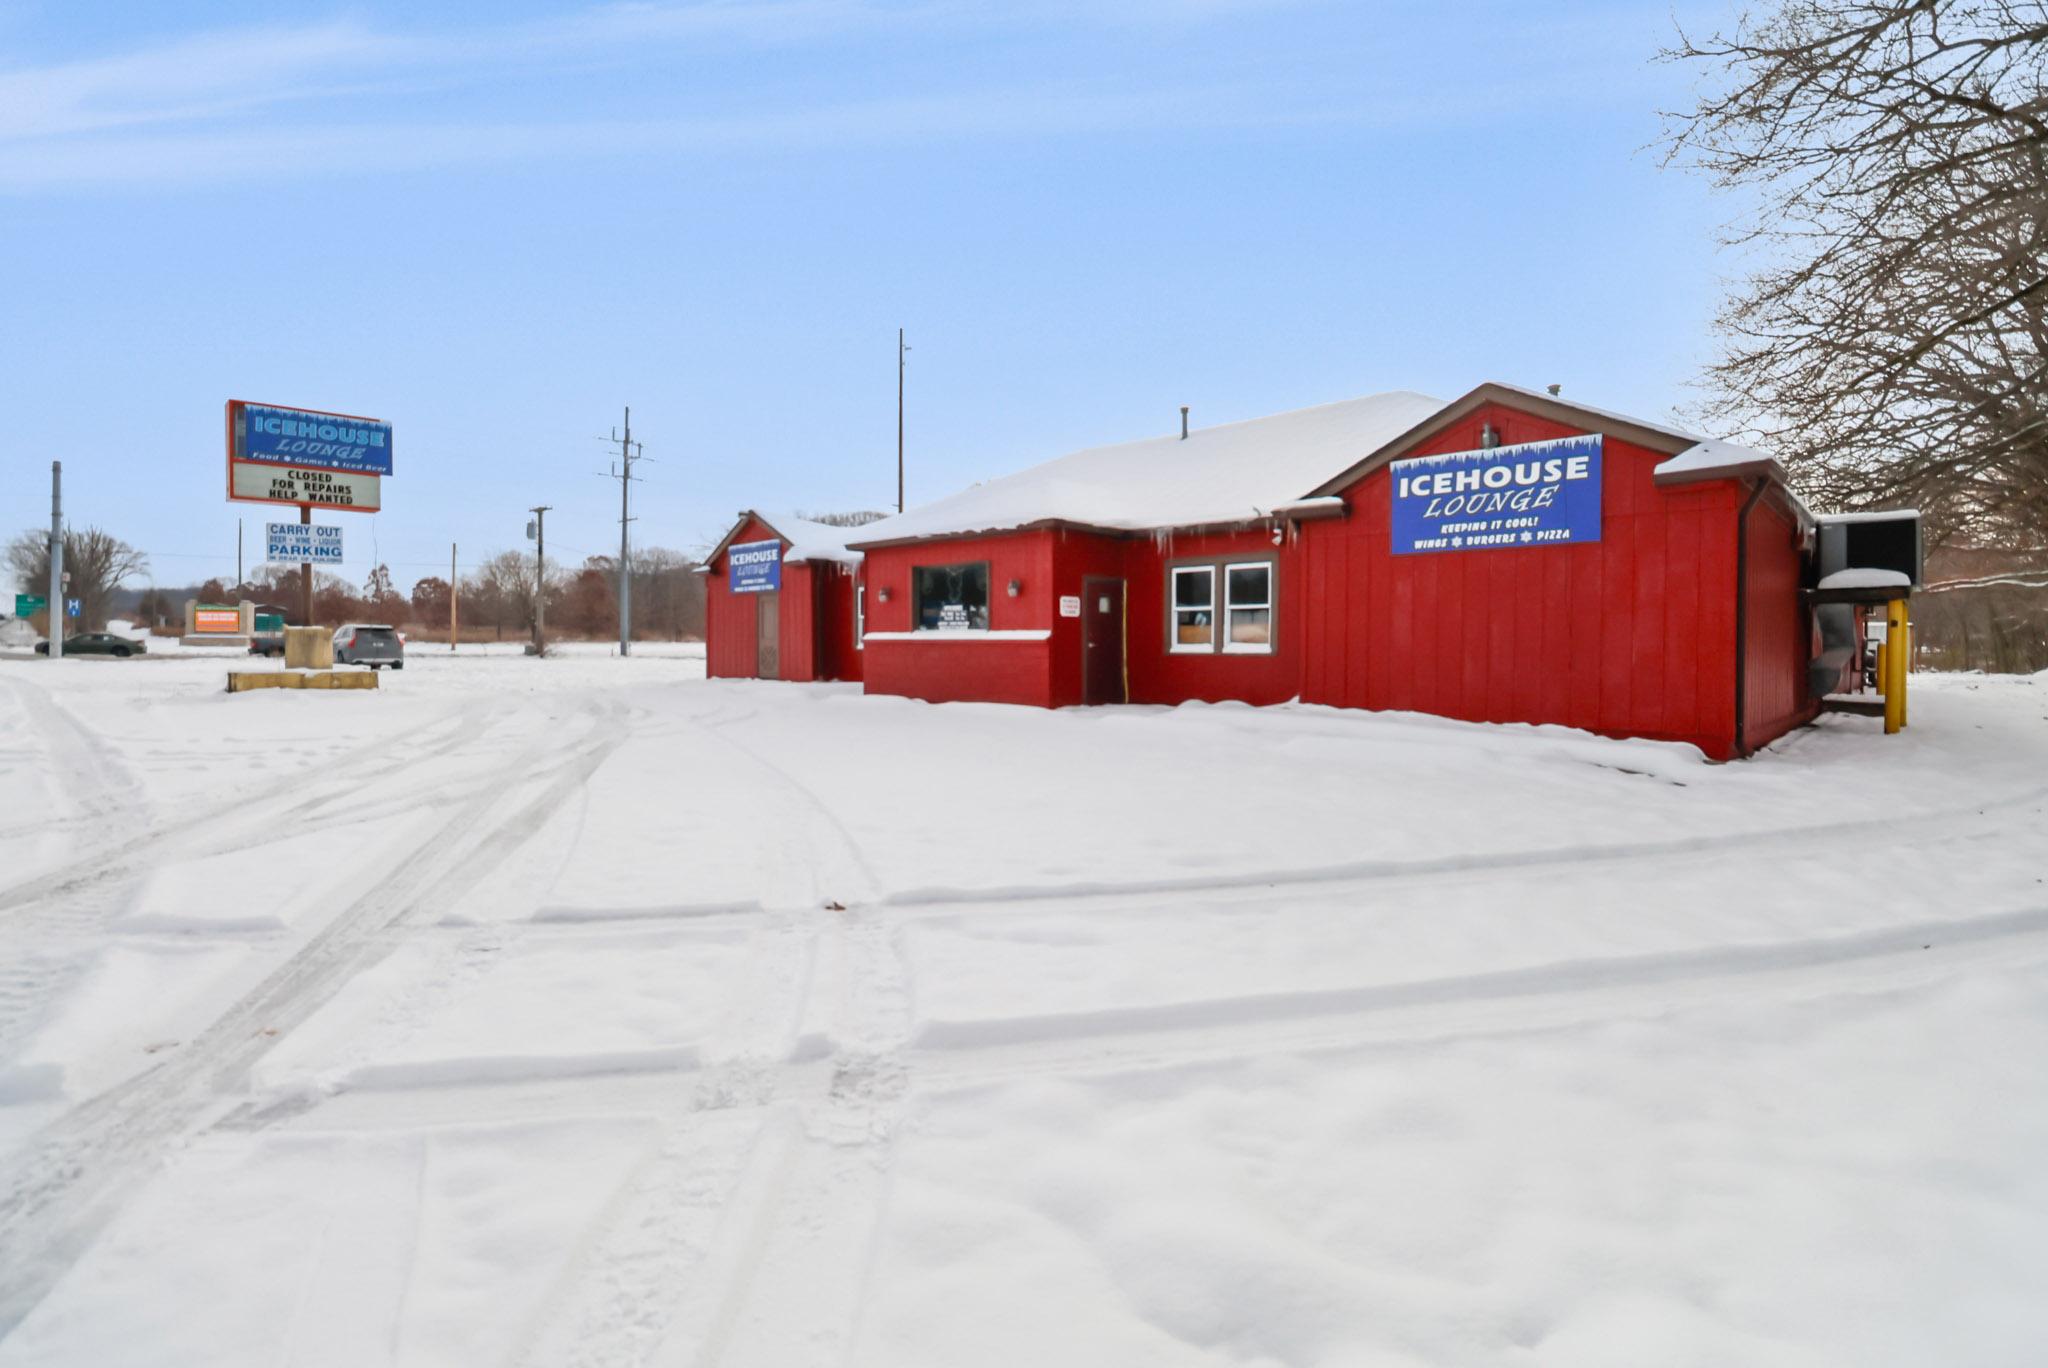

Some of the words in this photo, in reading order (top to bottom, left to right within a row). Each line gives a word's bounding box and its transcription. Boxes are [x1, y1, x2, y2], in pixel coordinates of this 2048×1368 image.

[255, 416, 384, 447] ICEHOUSE
[276, 439, 367, 459] LOUNGE
[253, 452, 279, 461] Food
[295, 456, 327, 466] Games
[366, 464, 387, 472] Beer
[288, 470, 332, 482] CLOSED
[1399, 456, 1589, 498] ICEHOUSE
[272, 479, 295, 489] FOR
[304, 482, 352, 495] REPAIRS
[269, 489, 298, 500] HELP
[309, 493, 353, 504] WANTED
[1423, 484, 1560, 518] LOUNGE
[270, 524, 310, 535] CARRY
[316, 527, 340, 536] OUT
[1440, 521, 1487, 534] KEEPING
[1490, 520, 1502, 530] IT
[1505, 517, 1539, 529] COOL!
[269, 535, 287, 543] BEER
[1414, 538, 1448, 550] WINGS
[1466, 533, 1516, 545] BURGERS
[1536, 529, 1570, 541] PIZZA
[269, 544, 342, 557] PARKING
[730, 549, 778, 566] ICEHOUSE
